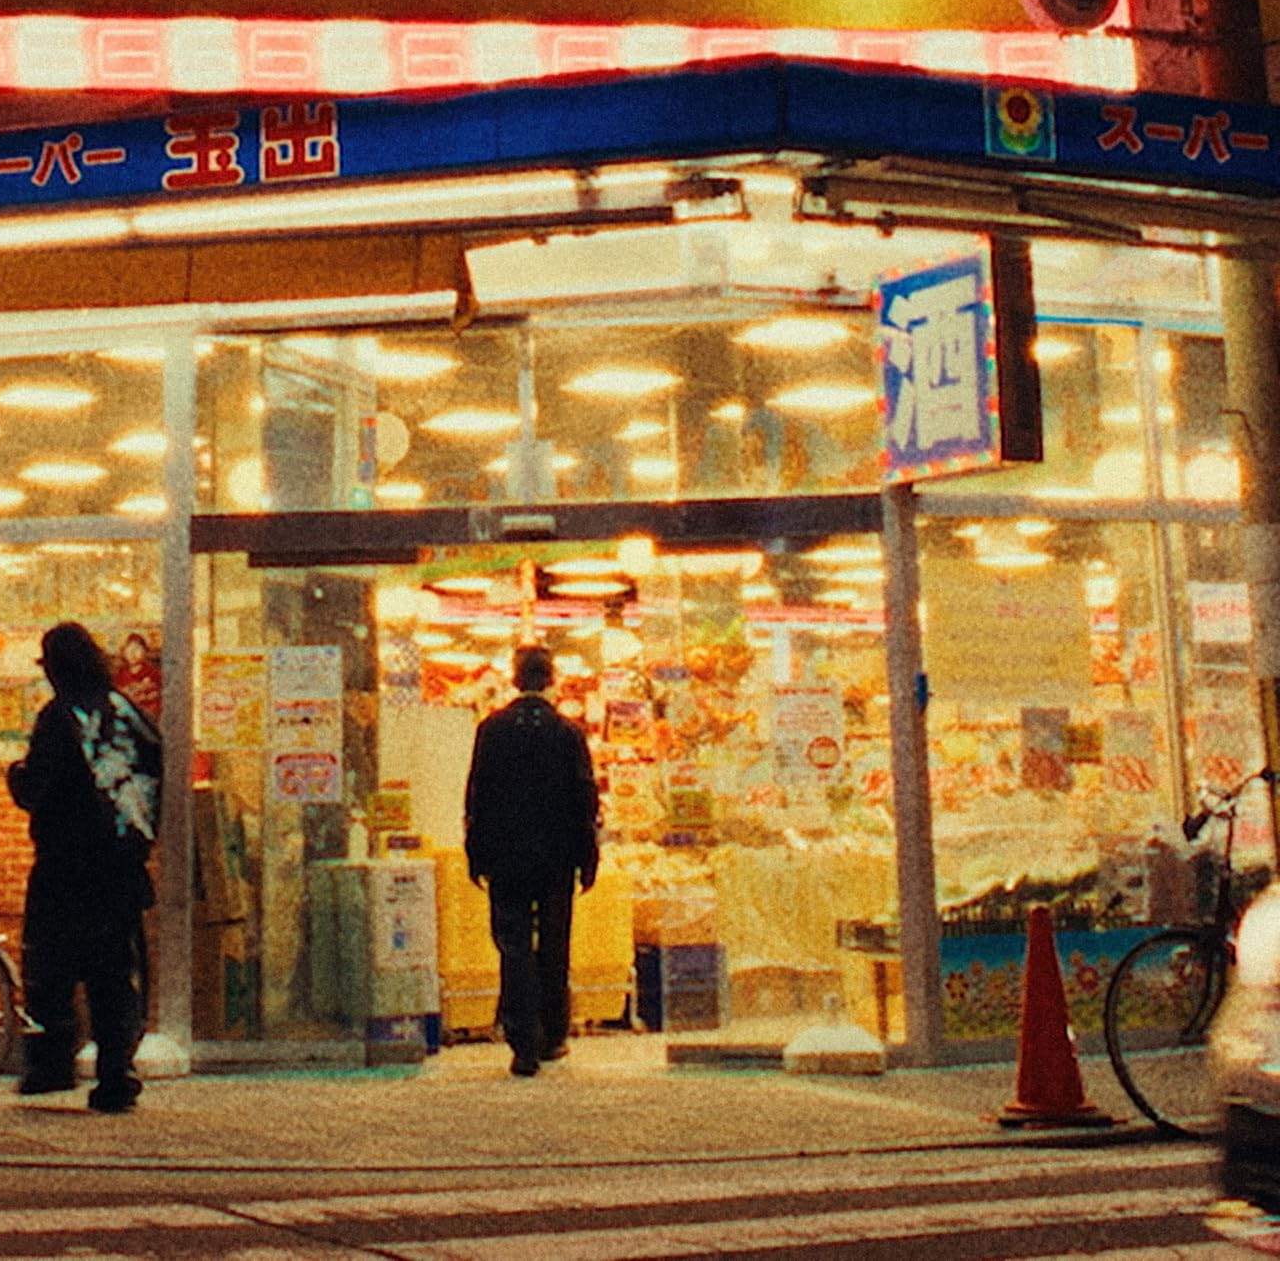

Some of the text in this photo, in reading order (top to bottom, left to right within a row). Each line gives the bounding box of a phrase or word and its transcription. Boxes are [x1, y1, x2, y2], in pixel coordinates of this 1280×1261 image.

[162, 102, 341, 192] 玉出
[1096, 105, 1270, 164] スーパー
[885, 271, 983, 452] 酒
